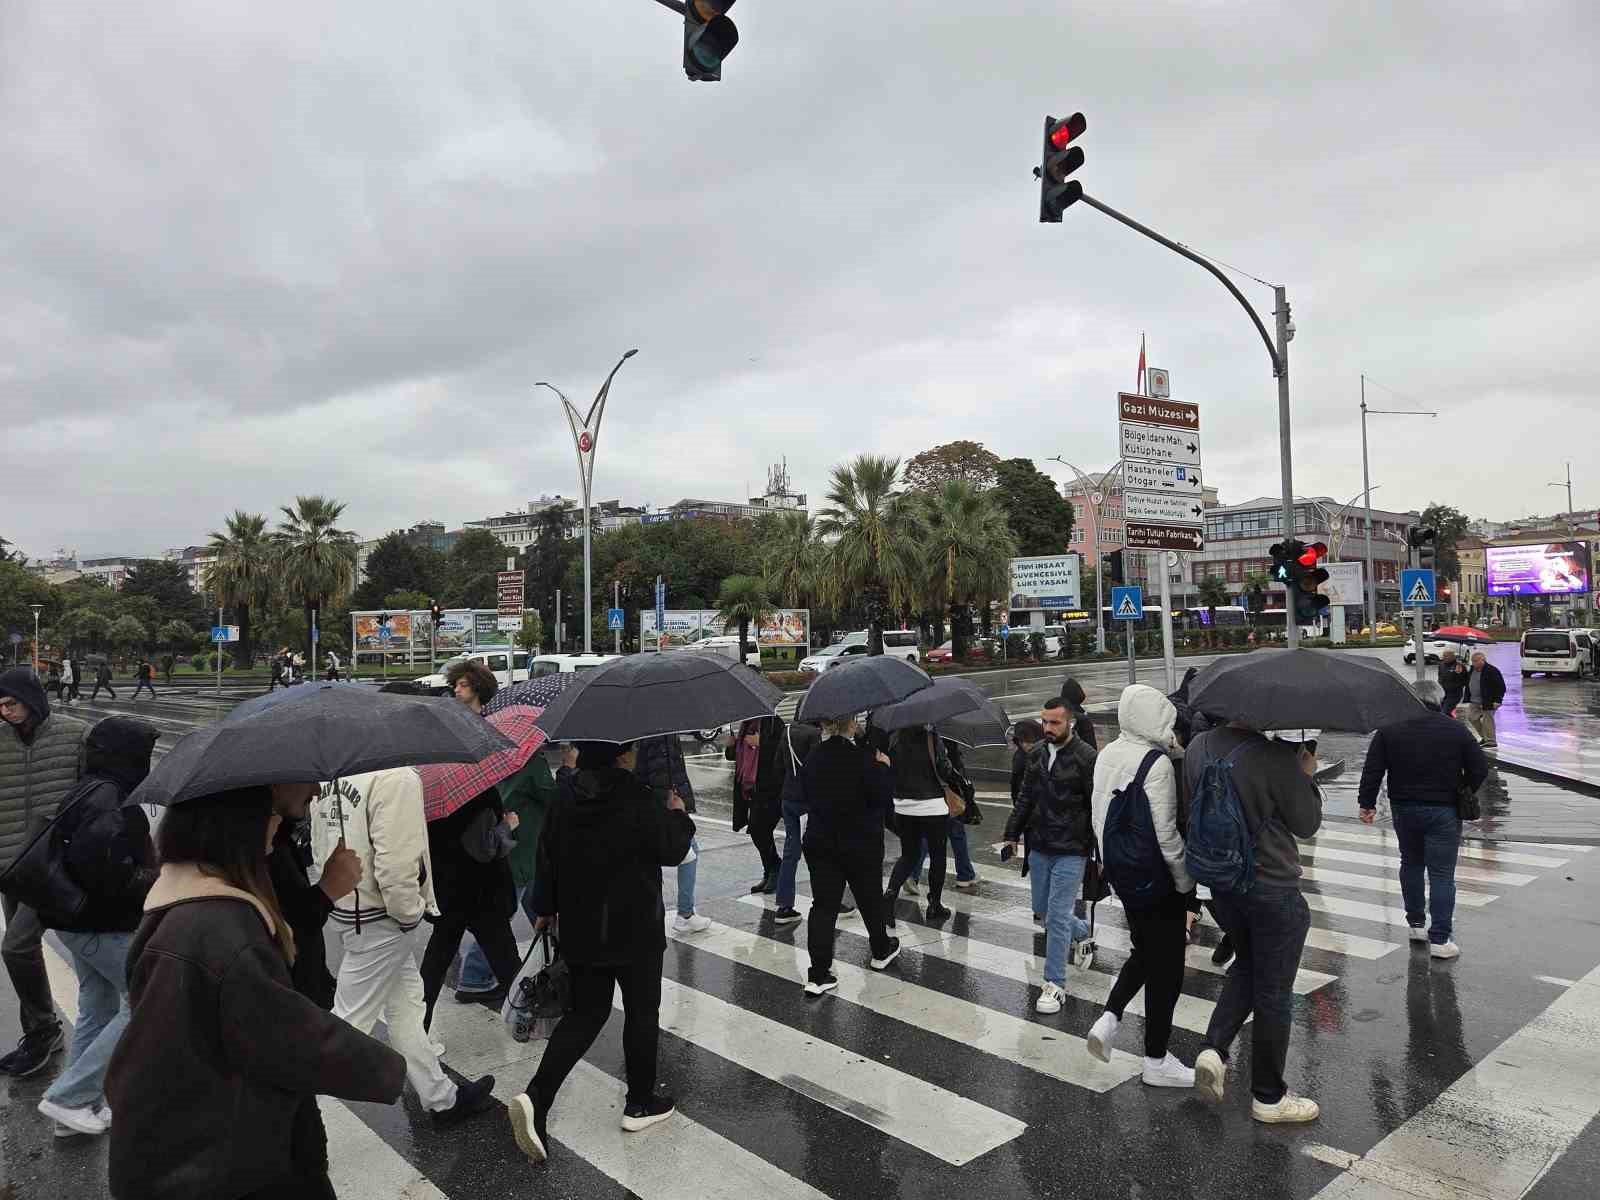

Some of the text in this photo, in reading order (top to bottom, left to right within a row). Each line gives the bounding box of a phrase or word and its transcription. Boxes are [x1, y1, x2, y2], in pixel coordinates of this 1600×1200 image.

[1123, 402, 1184, 420] Gazi Müzesi
[1127, 463, 1174, 476] Hastaneler
[1127, 475, 1157, 487] Otogar
[1128, 527, 1146, 537] Tarihi
